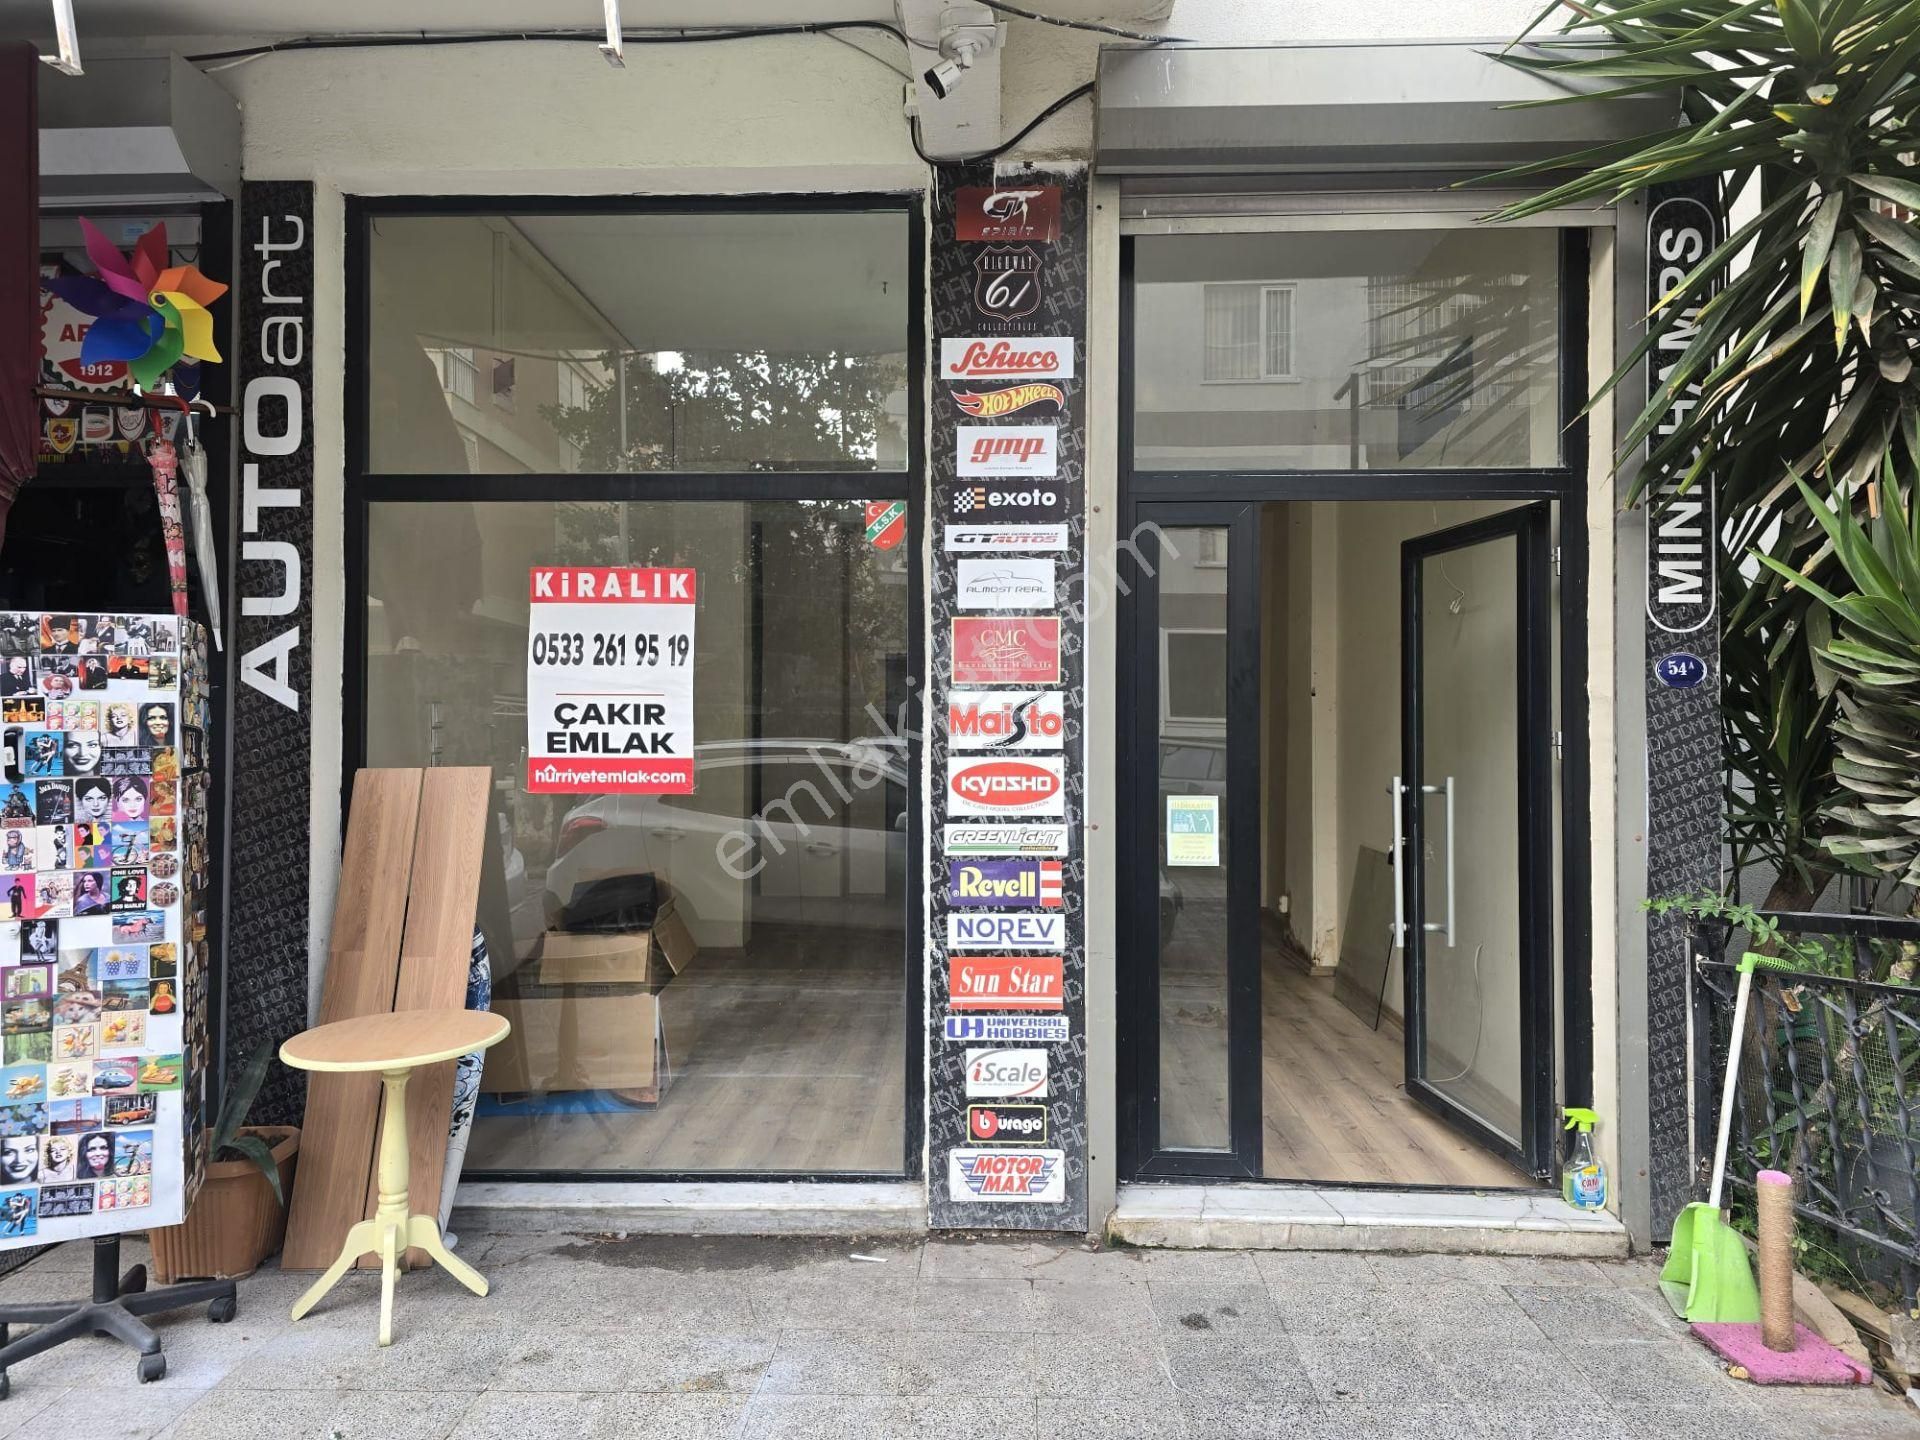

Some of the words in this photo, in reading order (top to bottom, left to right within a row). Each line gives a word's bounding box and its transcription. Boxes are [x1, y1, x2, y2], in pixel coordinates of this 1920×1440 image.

[984, 255, 1032, 270] HIGHWAY
[985, 268, 1031, 308] 61
[950, 341, 1059, 374] Schuco
[79, 364, 114, 376] 1912
[970, 438, 1047, 463] gmp
[988, 488, 1057, 507] exoto
[980, 629, 1027, 647] CMC
[532, 632, 584, 666] 0533
[593, 633, 626, 666] 261
[635, 633, 659, 667] 95
[668, 634, 690, 667] 19
[554, 702, 666, 730] ÇAKIR
[546, 731, 675, 754] EMLAK
[959, 866, 1036, 897] Revell
[957, 918, 1055, 942] NOREV
[959, 966, 999, 993] Sun
[1008, 966, 1054, 993] Star
[987, 1018, 1066, 1027] UNIVERSAL
[987, 1027, 1067, 1039] HOBBIES
[973, 1062, 1042, 1082] iScale
[973, 1157, 1045, 1174] MOTOR
[982, 1176, 1032, 1193] MAX
